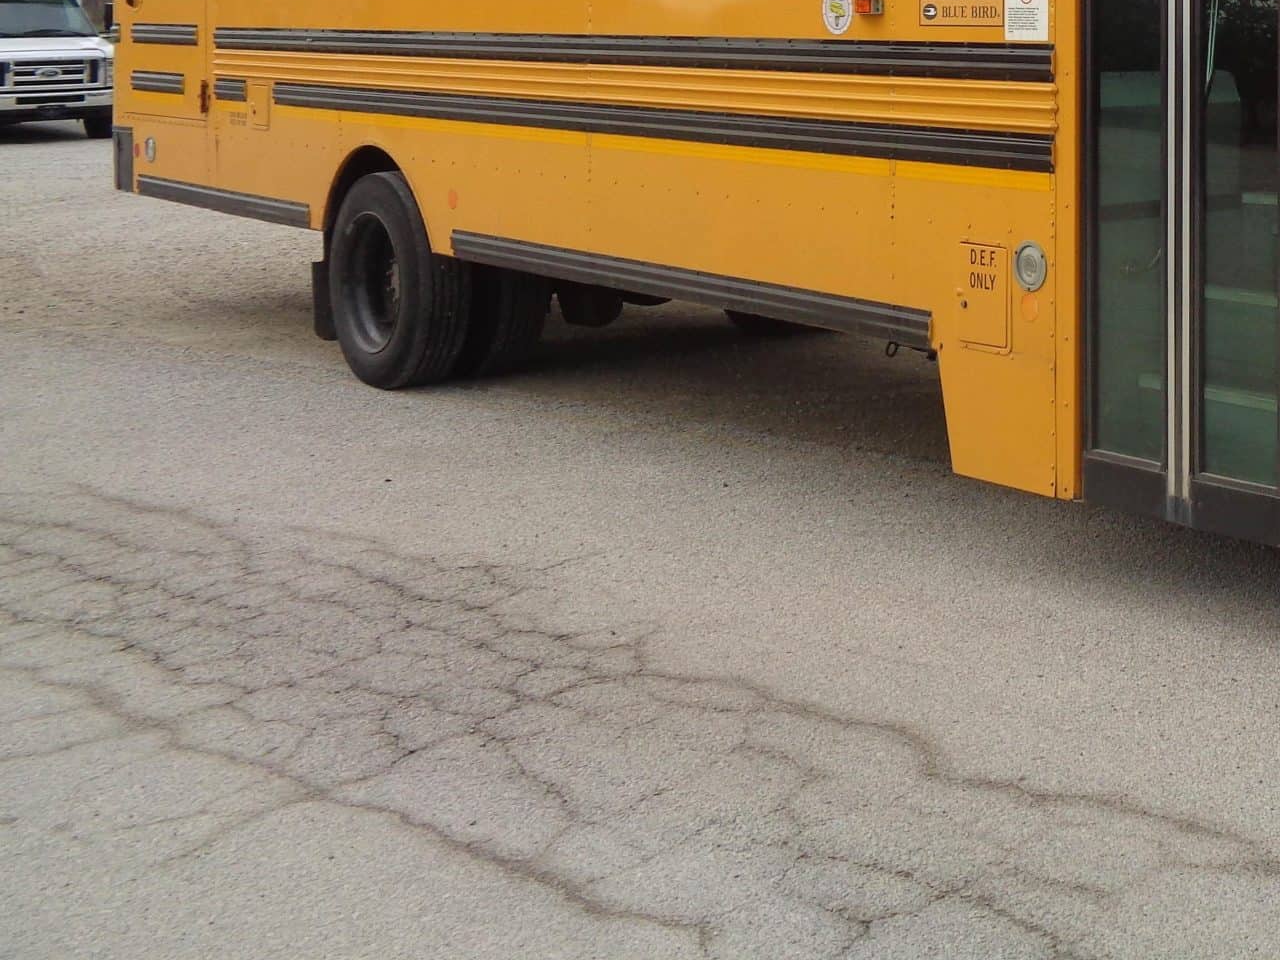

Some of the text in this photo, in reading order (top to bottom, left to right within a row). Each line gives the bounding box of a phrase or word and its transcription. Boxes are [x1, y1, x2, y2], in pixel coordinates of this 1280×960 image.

[941, 5, 967, 18] BLUE
[970, 248, 998, 269] D.E.F.
[969, 271, 997, 292] ONLY
